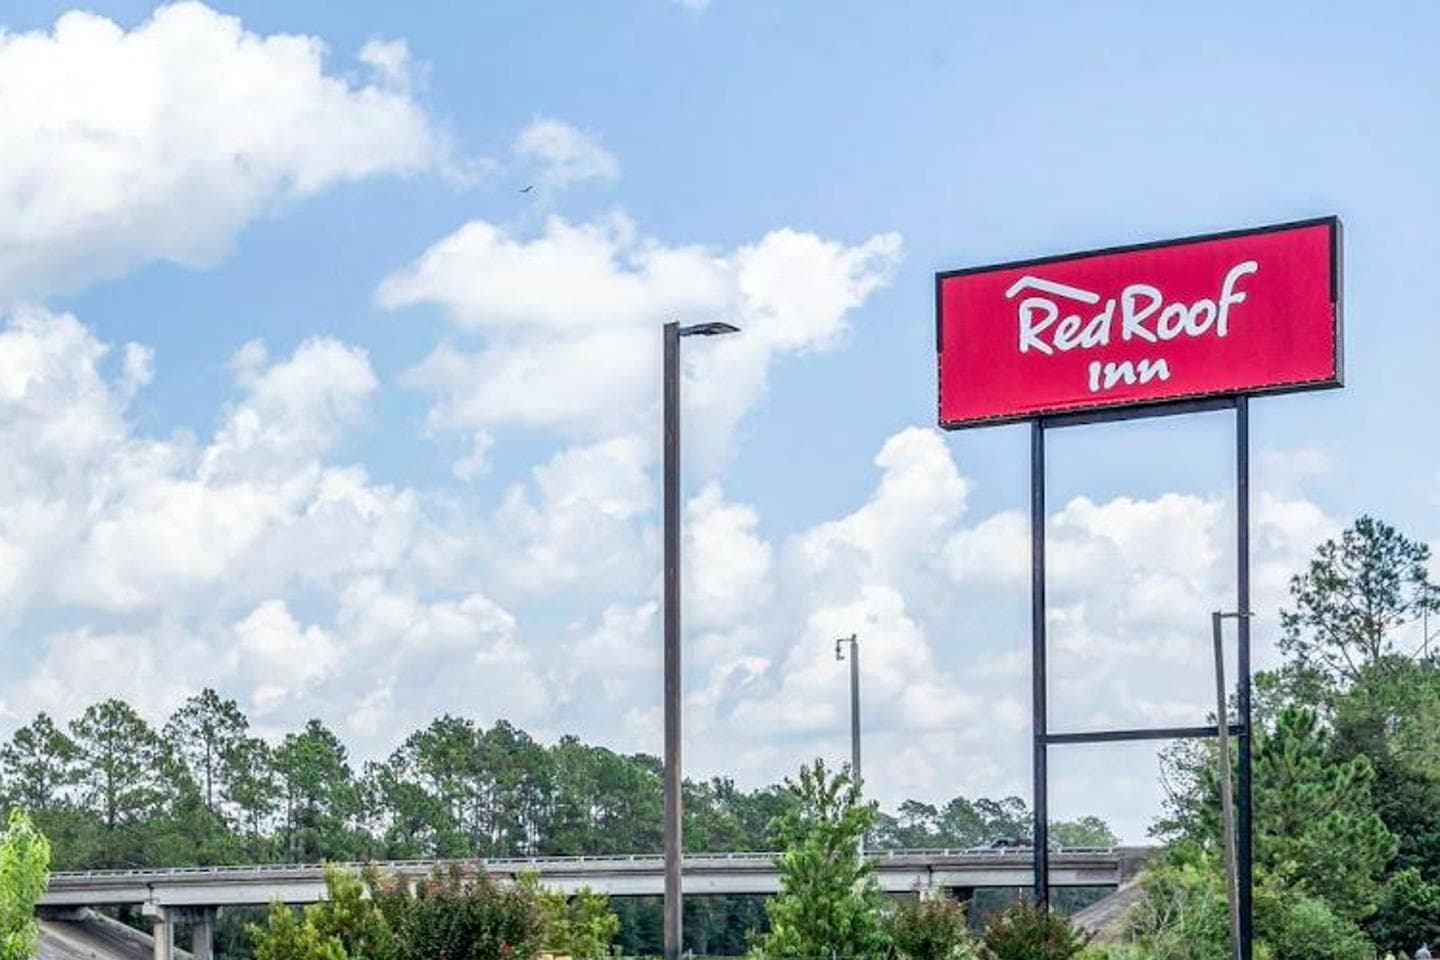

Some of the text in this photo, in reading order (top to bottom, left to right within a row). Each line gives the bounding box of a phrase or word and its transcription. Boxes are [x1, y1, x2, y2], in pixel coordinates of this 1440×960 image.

[1018, 260, 1258, 355] Red Roof
[1088, 358, 1170, 392] Inn
